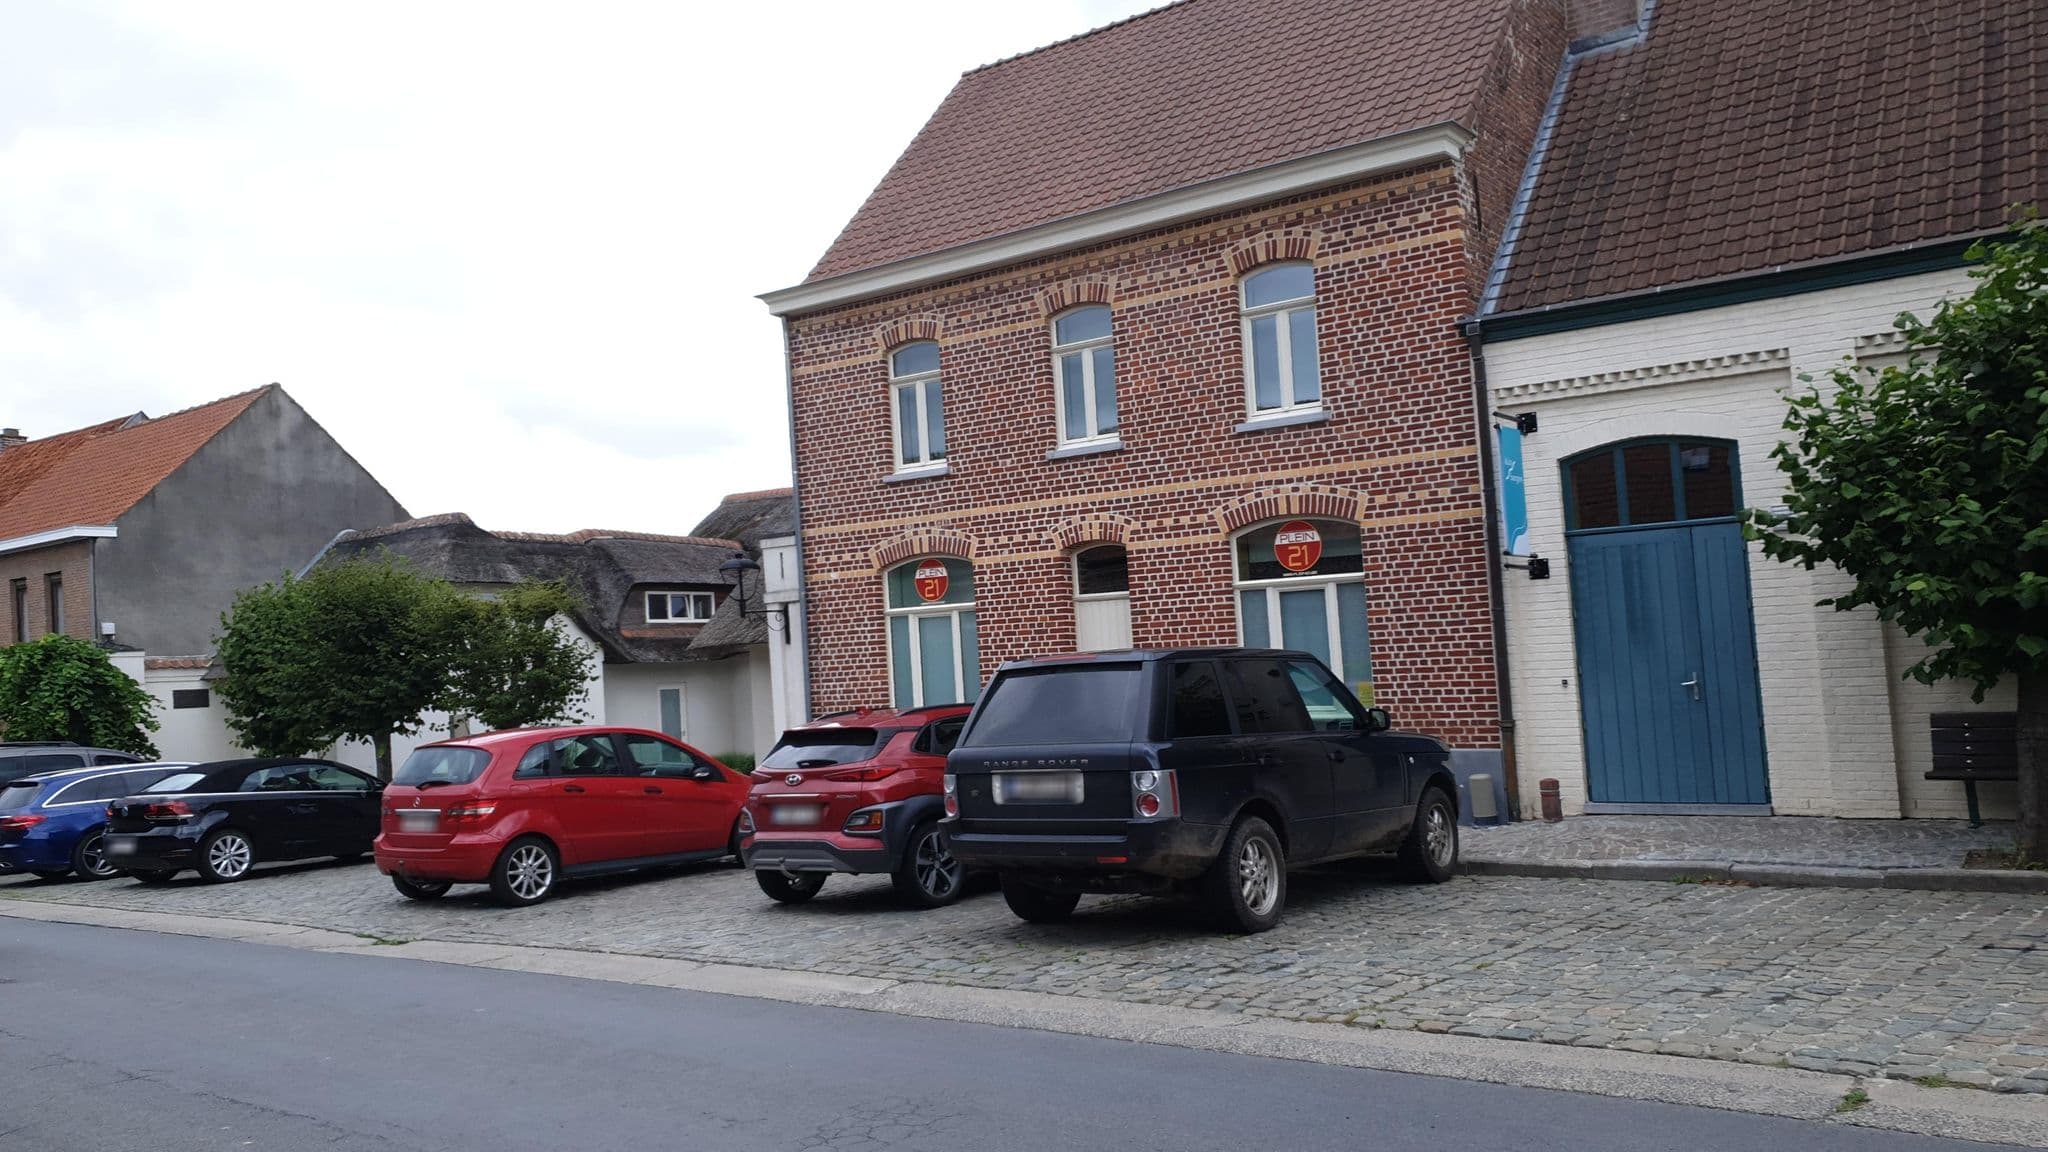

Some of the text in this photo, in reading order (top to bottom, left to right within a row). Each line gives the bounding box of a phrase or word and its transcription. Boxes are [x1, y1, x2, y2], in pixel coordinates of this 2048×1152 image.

[1279, 531, 1315, 543] PLEIN
[1287, 544, 1309, 567] 21
[918, 568, 944, 577] PLEIN
[925, 579, 940, 598] 21
[983, 760, 1029, 768] RANGE
